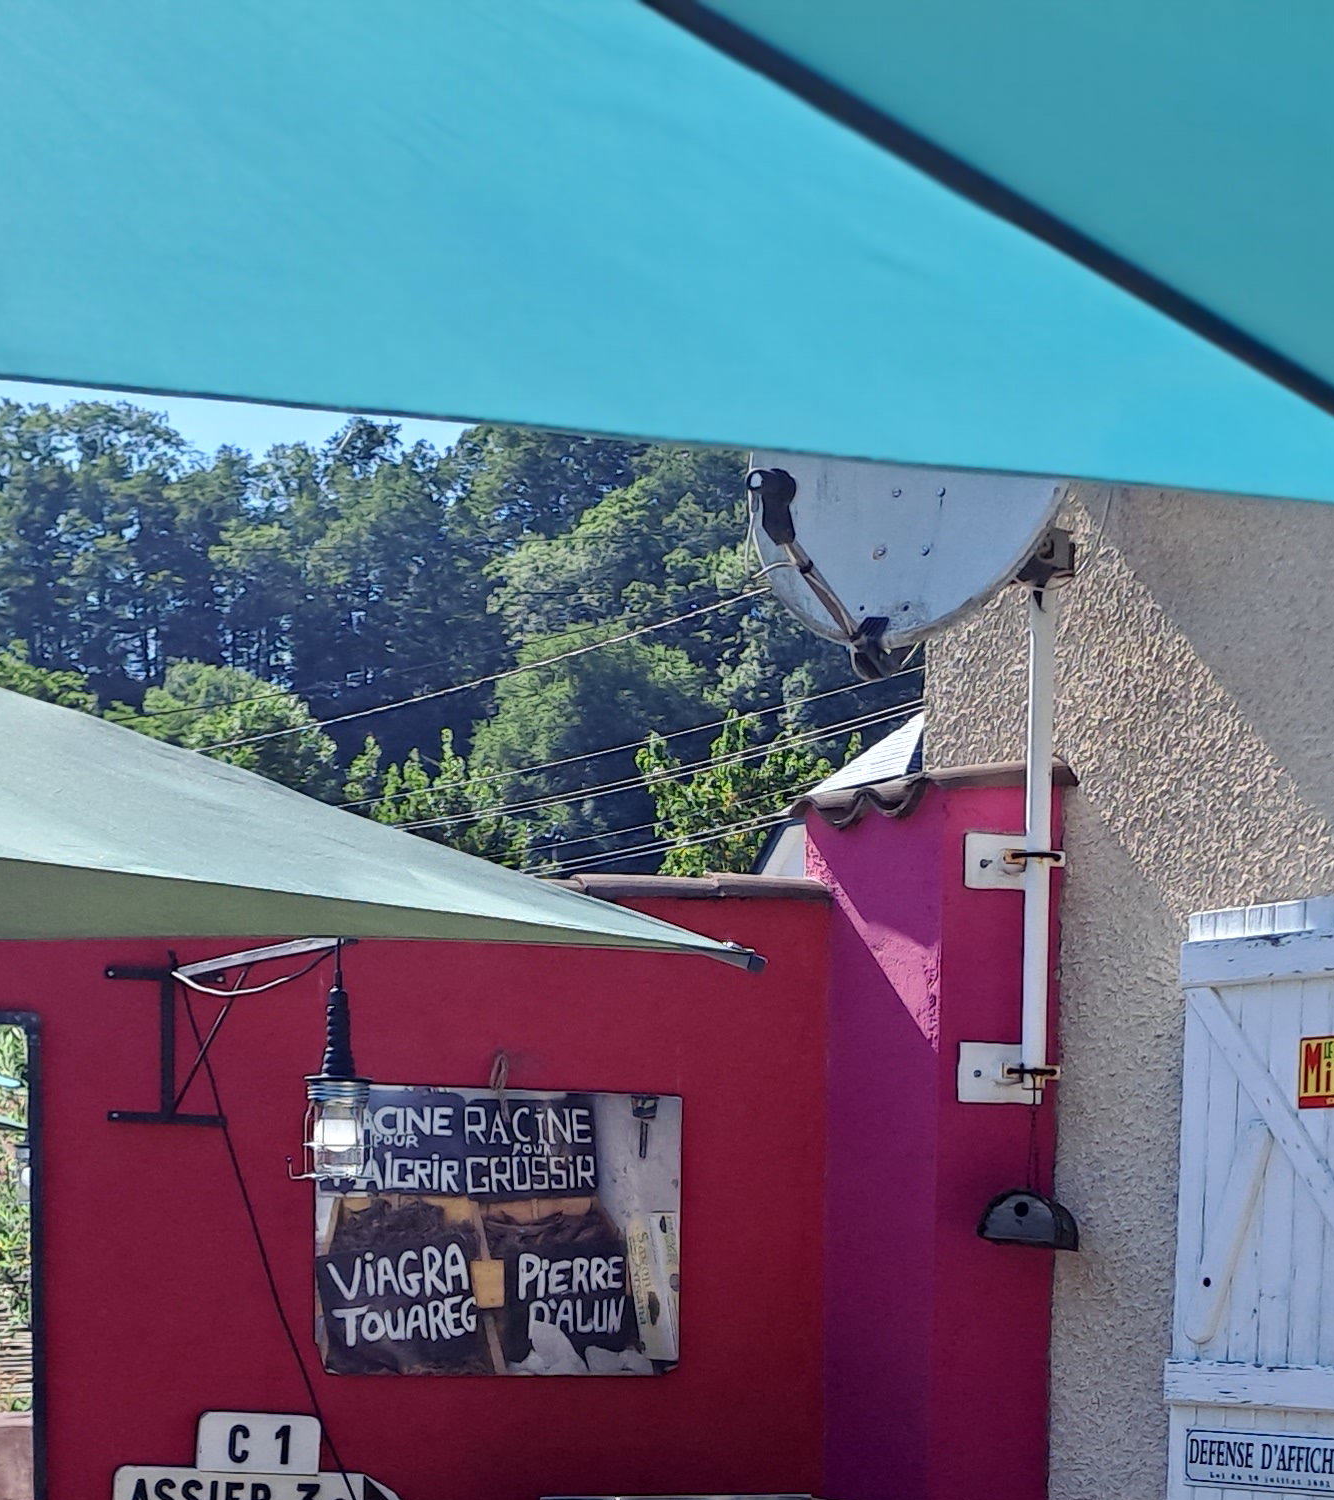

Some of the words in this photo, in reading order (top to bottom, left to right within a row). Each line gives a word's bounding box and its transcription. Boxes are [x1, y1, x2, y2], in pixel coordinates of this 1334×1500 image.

[362, 1105, 454, 1136] ACINE
[373, 1133, 419, 1149] POUR
[511, 1142, 553, 1156] POUR
[331, 1295, 477, 1348] TOUAREG
[228, 1424, 250, 1464] C
[274, 1424, 292, 1465] 1
[1188, 1438, 1254, 1469] DEFENSE
